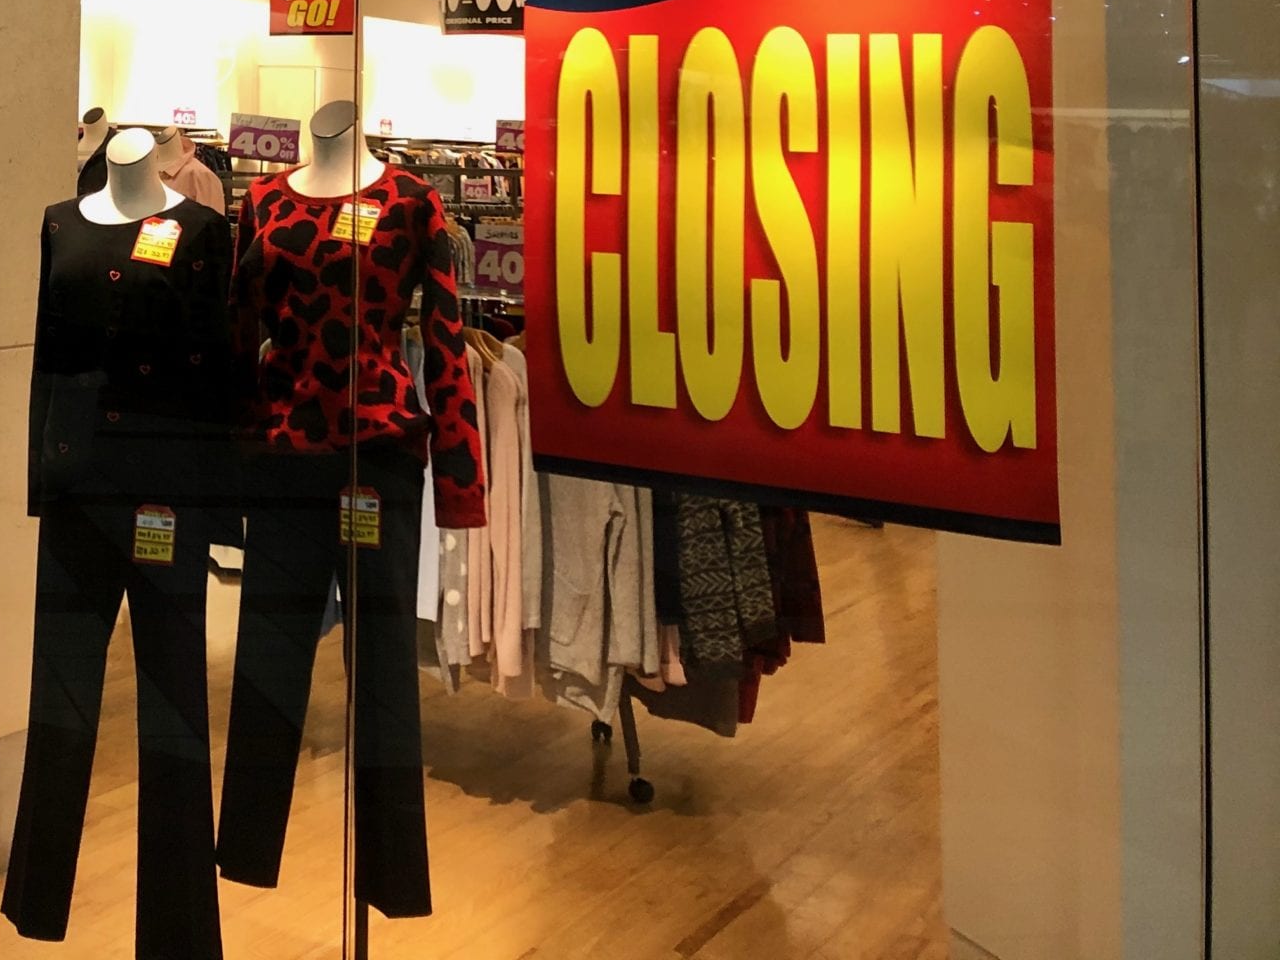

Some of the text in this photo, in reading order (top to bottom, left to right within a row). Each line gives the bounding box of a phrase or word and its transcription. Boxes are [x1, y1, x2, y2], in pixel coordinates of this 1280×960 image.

[287, 0, 340, 28] GO!
[280, 149, 295, 159] OFF
[555, 25, 1038, 454] CLOSING
